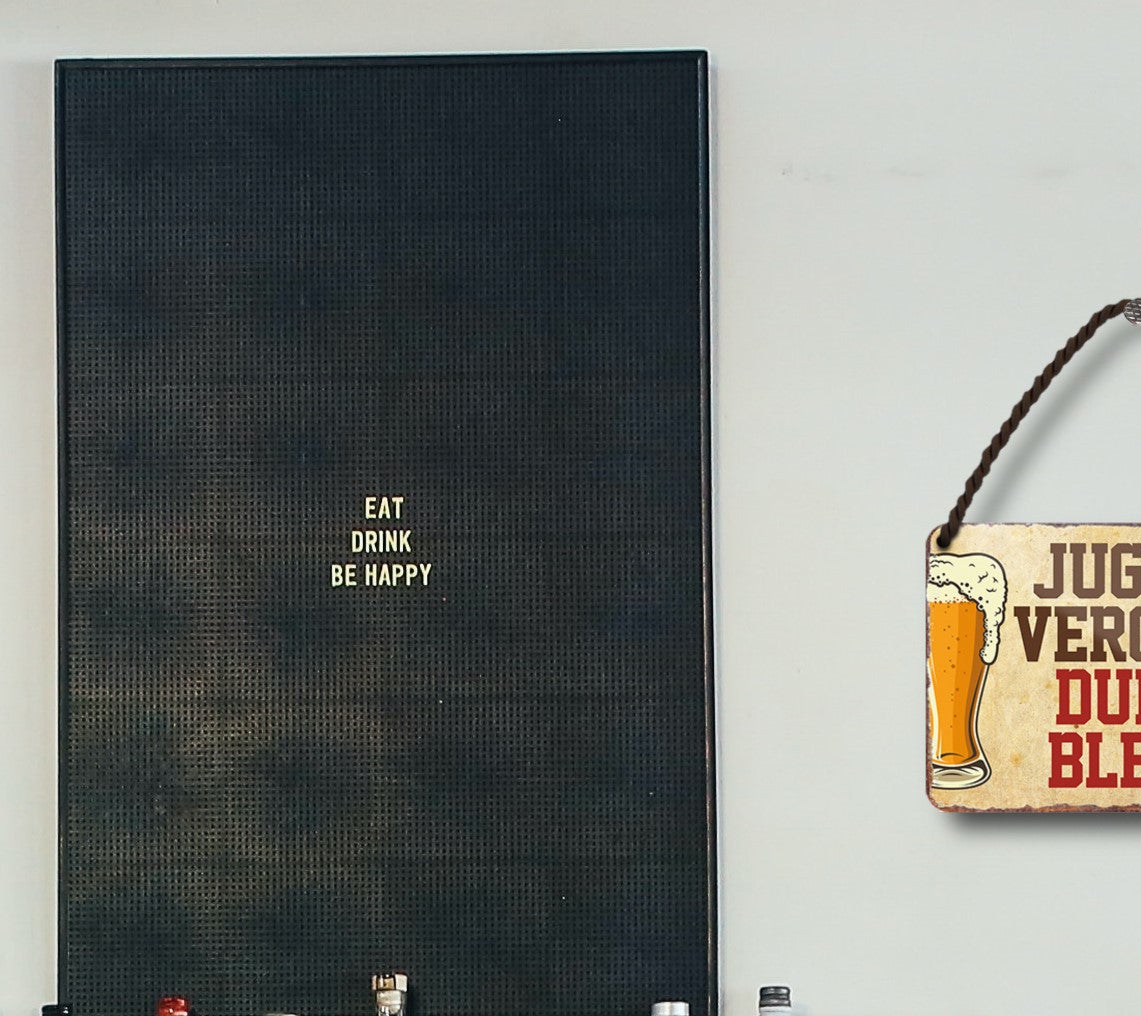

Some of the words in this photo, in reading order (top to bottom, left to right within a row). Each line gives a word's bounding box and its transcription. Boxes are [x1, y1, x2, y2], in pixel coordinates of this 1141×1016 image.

[365, 496, 404, 520] EAT
[351, 529, 412, 554] DRINK
[331, 563, 358, 588] BE
[365, 563, 432, 587] HAPPY
